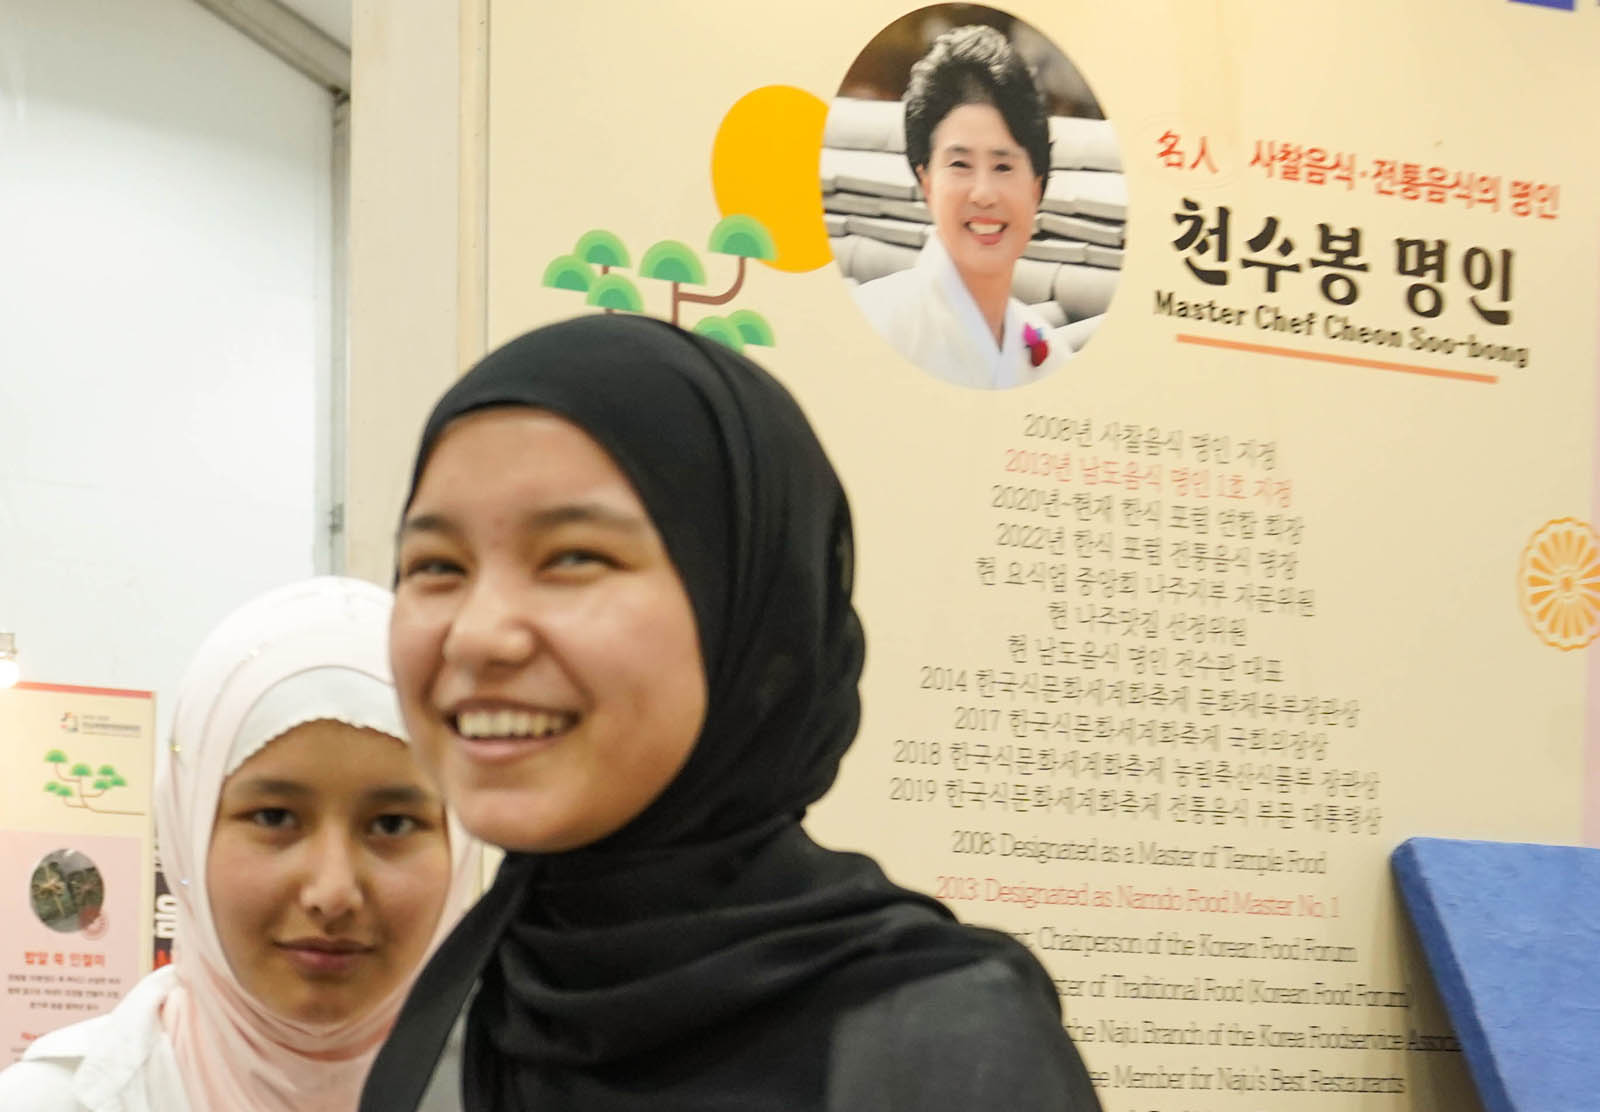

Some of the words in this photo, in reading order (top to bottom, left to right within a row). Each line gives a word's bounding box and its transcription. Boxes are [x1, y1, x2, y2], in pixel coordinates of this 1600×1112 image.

[1507, 180, 1561, 220] 명인
[1172, 197, 1371, 306] 천수봉
[1393, 235, 1517, 326] 명인
[1154, 290, 1247, 326] Master
[1253, 304, 1329, 338] Chef
[1323, 313, 1403, 350] Cheon
[1408, 327, 1531, 369] Soo-bong
[1024, 413, 1091, 447] 2008년
[1005, 449, 1071, 482] 2013년
[1079, 456, 1165, 492] 남도음식
[996, 522, 1065, 557] 2022년
[1034, 637, 1119, 671] 남도음식
[919, 665, 968, 692] 2014
[953, 706, 1001, 732] 2017
[893, 739, 942, 766] 2018
[889, 776, 938, 803] 2019
[1000, 832, 1099, 864] Designated
[1100, 845, 1120, 864] as
[1122, 847, 1134, 865] a
[1137, 841, 1198, 868] Master
[1200, 845, 1219, 869] of
[1222, 846, 1284, 877] Temple
[1287, 849, 1328, 875] Food
[985, 878, 1089, 910] Designated
[1091, 890, 1112, 909] as
[1116, 885, 1184, 912] Namdo
[1186, 888, 1231, 914] Food
[1233, 891, 1295, 917] Master
[1038, 926, 1144, 958] Chairperson
[1145, 930, 1164, 956] of
[1165, 931, 1196, 957] the
[1199, 933, 1261, 959] Korean
[1261, 936, 1300, 962] Food
[1304, 939, 1358, 964] Forum
[1089, 974, 1107, 1000] of
[1112, 974, 1201, 1002] Traditional
[1204, 977, 1244, 1003] Food
[1314, 982, 1352, 1007] Food
[1098, 1019, 1138, 1049] Naju
[1143, 1021, 1202, 1048] Branch
[1203, 1023, 1223, 1047] of
[1226, 1024, 1255, 1049] the
[1259, 1025, 1305, 1050] Korea
[1114, 1065, 1188, 1092] Member
[1189, 1066, 1214, 1091] for
[1270, 1069, 1305, 1093] Best
[1311, 1069, 1406, 1094] Restaurants
